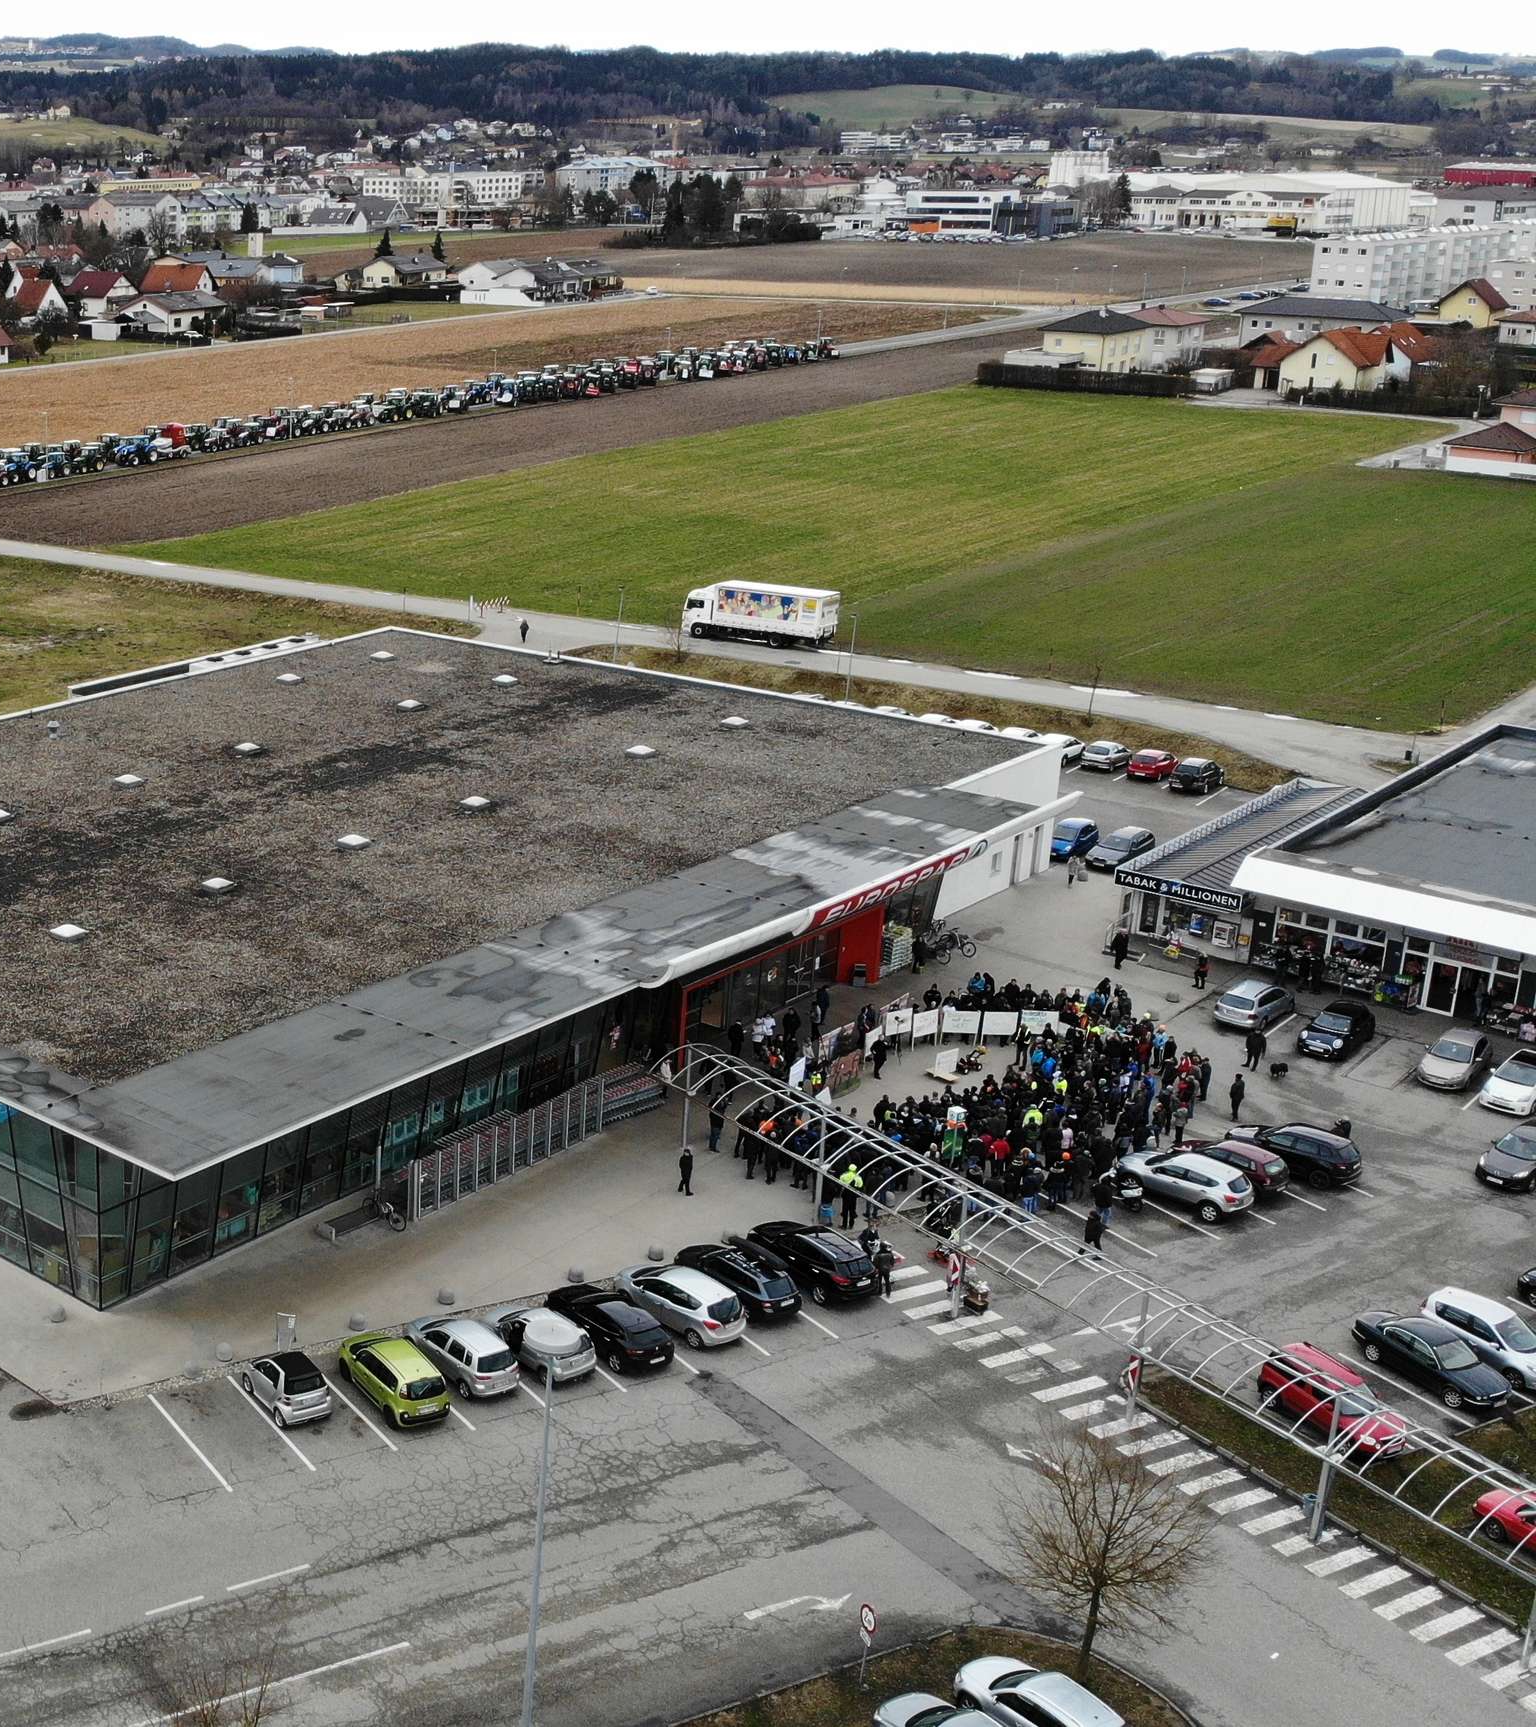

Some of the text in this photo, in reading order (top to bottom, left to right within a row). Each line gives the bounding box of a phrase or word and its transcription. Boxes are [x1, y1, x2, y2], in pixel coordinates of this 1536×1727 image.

[820, 847, 972, 925] EUROSPAR
[1118, 873, 1238, 907] TABAK & MILLIONEN
